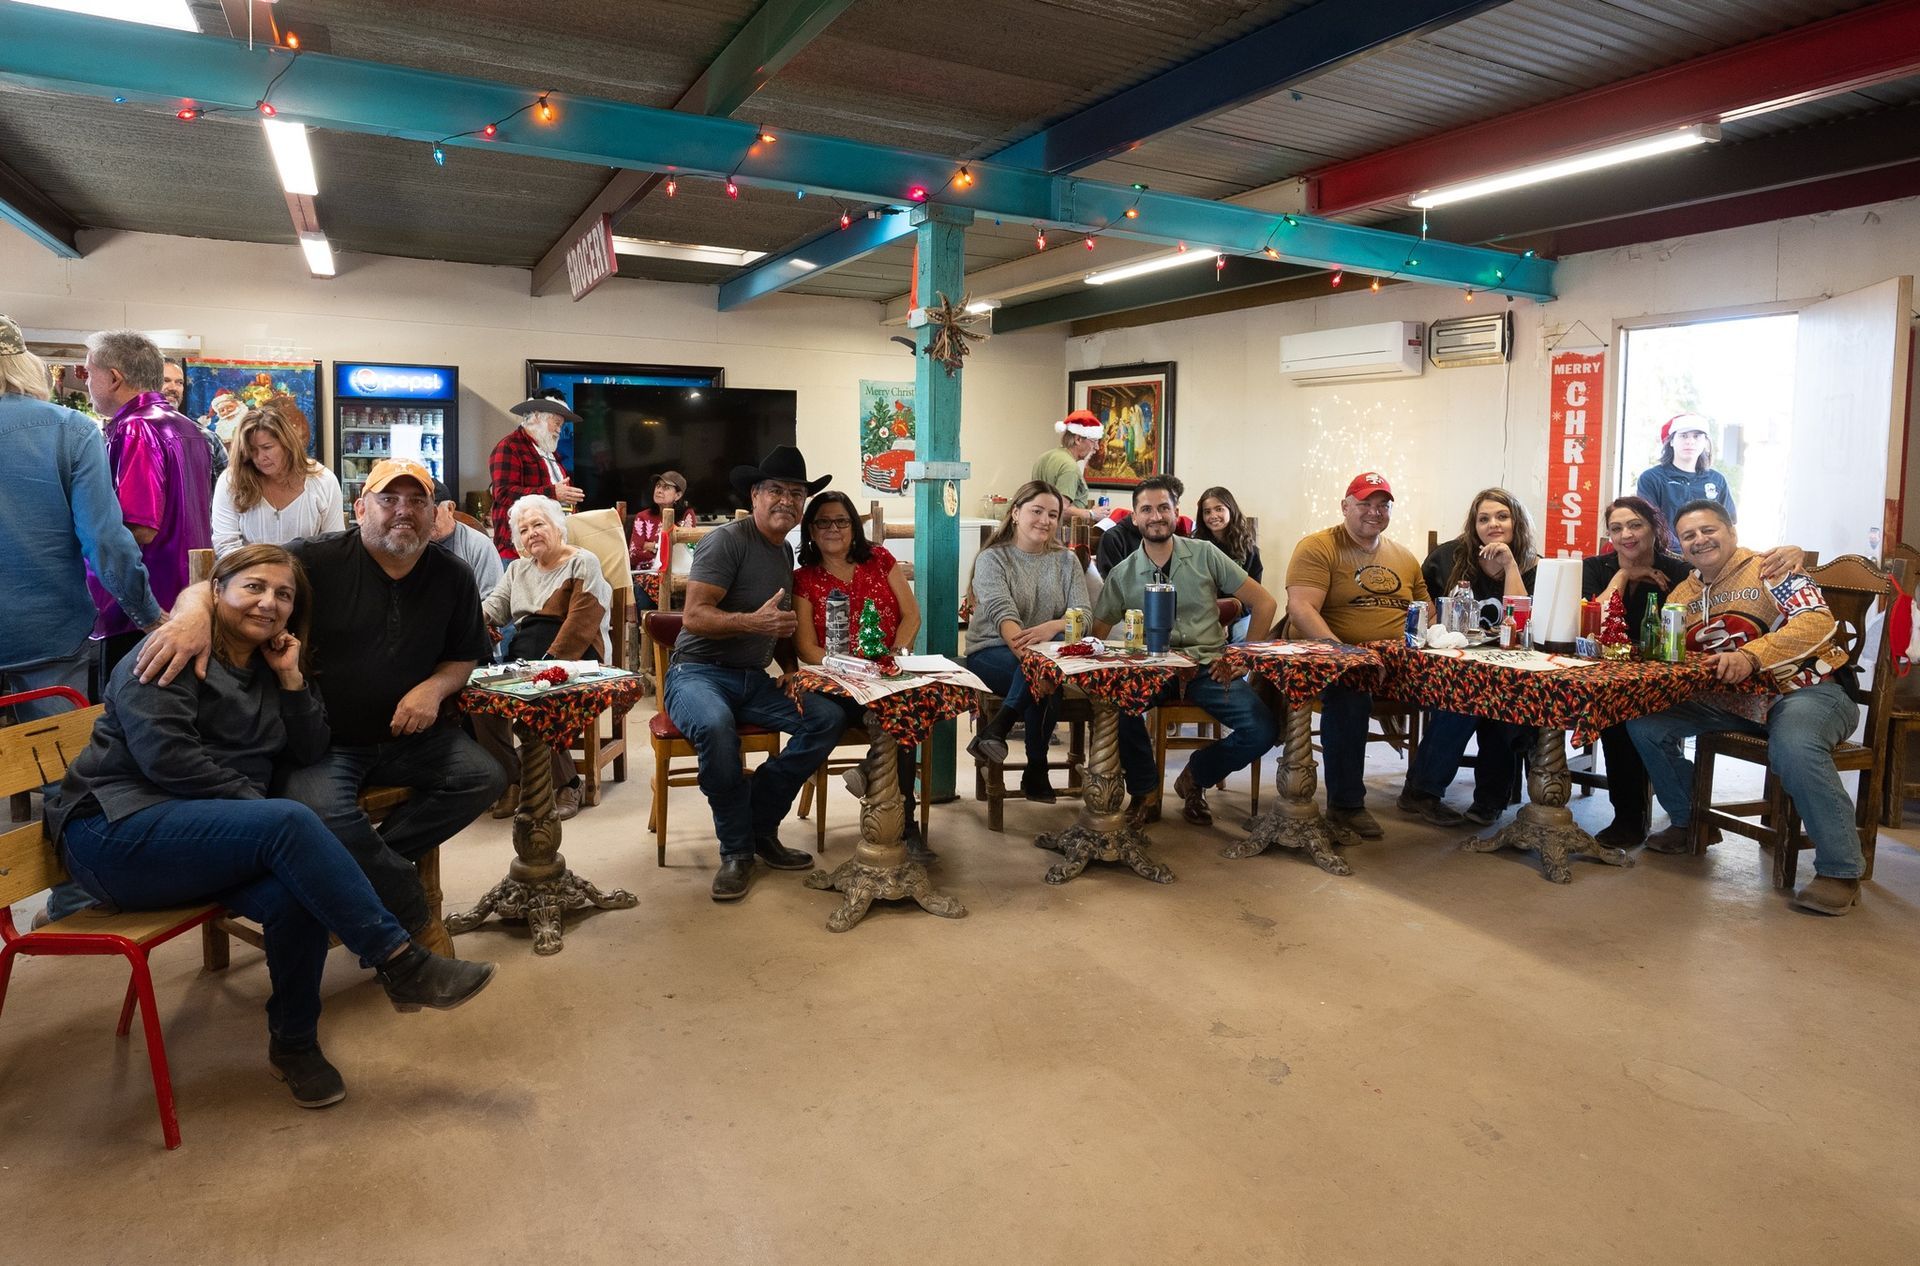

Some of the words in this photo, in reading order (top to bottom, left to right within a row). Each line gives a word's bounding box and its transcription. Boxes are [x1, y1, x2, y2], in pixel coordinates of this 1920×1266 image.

[566, 219, 609, 297] GROCERY
[1554, 362, 1601, 375] MERRY
[380, 373, 441, 392] pepsi
[865, 385, 890, 398] Merry
[891, 386, 914, 397] Christ
[1557, 381, 1587, 559] CHRIST
